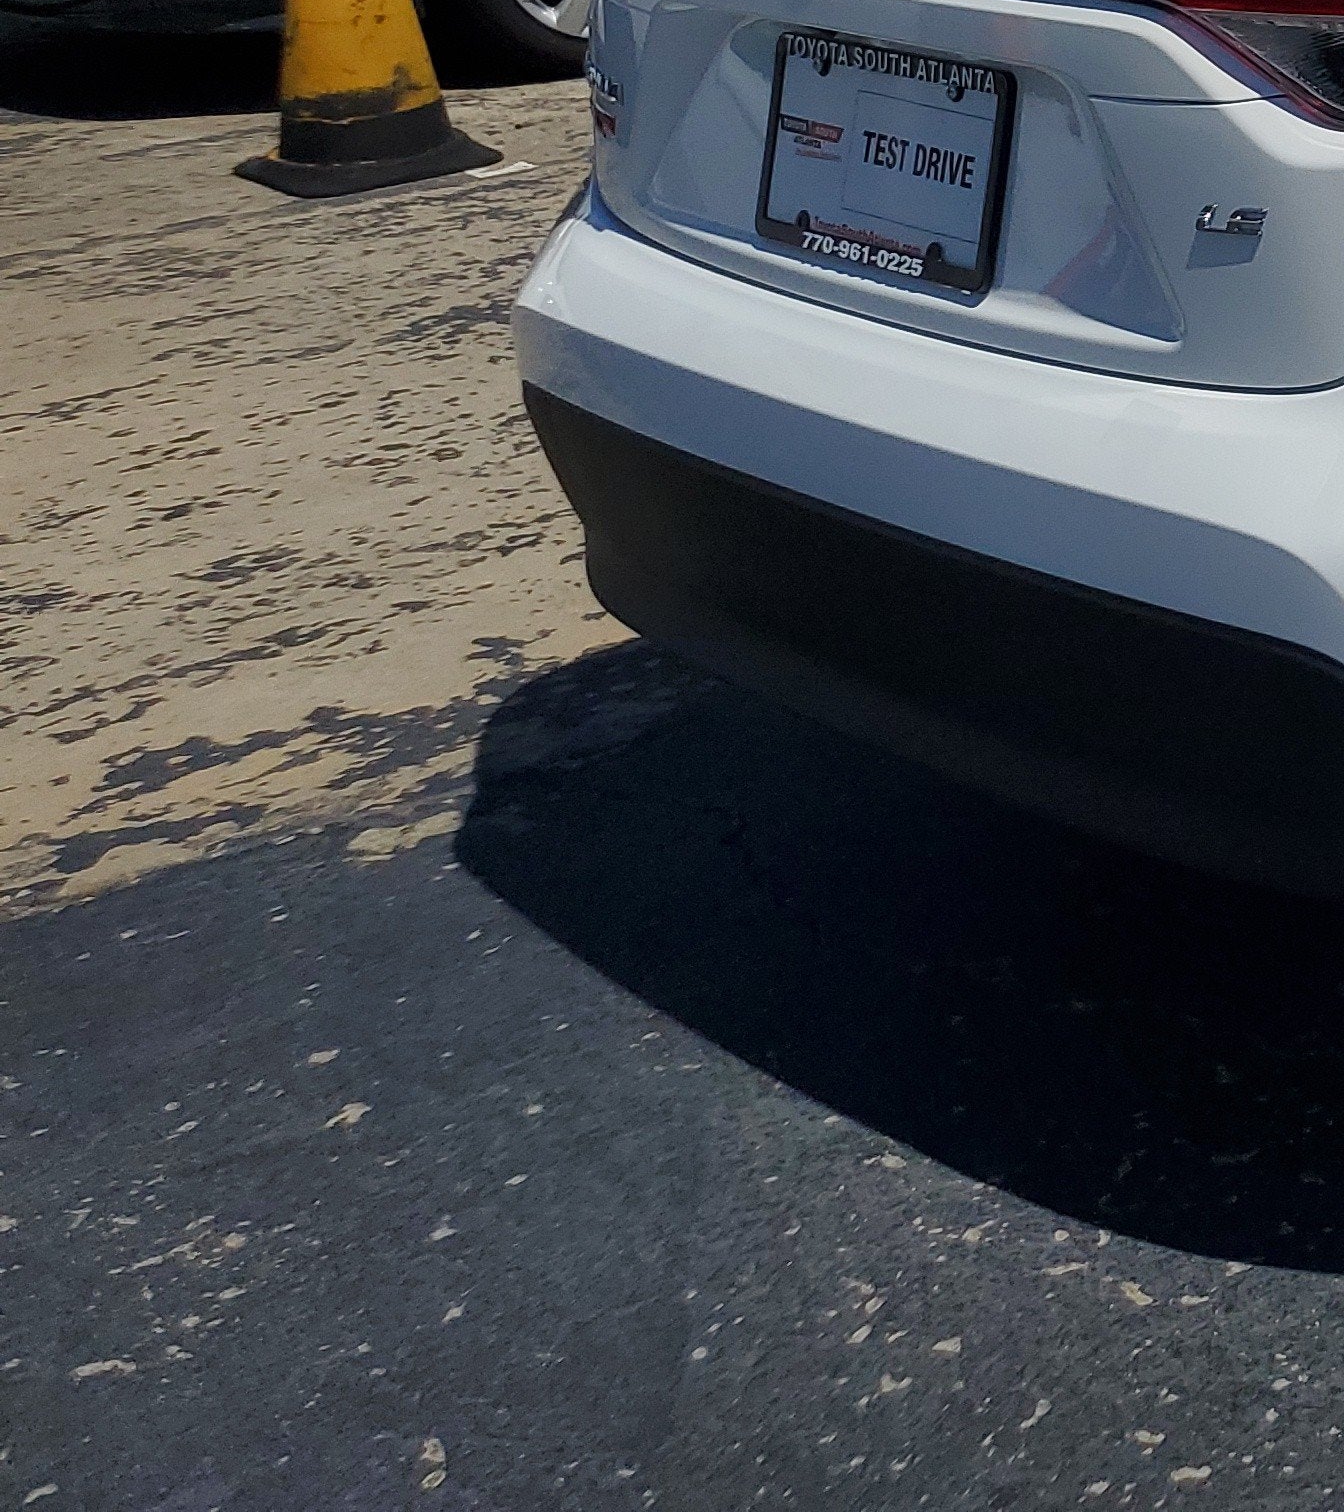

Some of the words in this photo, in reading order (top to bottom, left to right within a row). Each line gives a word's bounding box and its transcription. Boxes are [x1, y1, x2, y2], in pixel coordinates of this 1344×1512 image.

[785, 34, 849, 67] TOYOTA
[853, 46, 911, 78] SOUTH
[916, 58, 996, 94] ATLANTA
[863, 129, 910, 172] TEST
[912, 143, 976, 189] DRIVE
[802, 231, 924, 277] 770-961-0225
